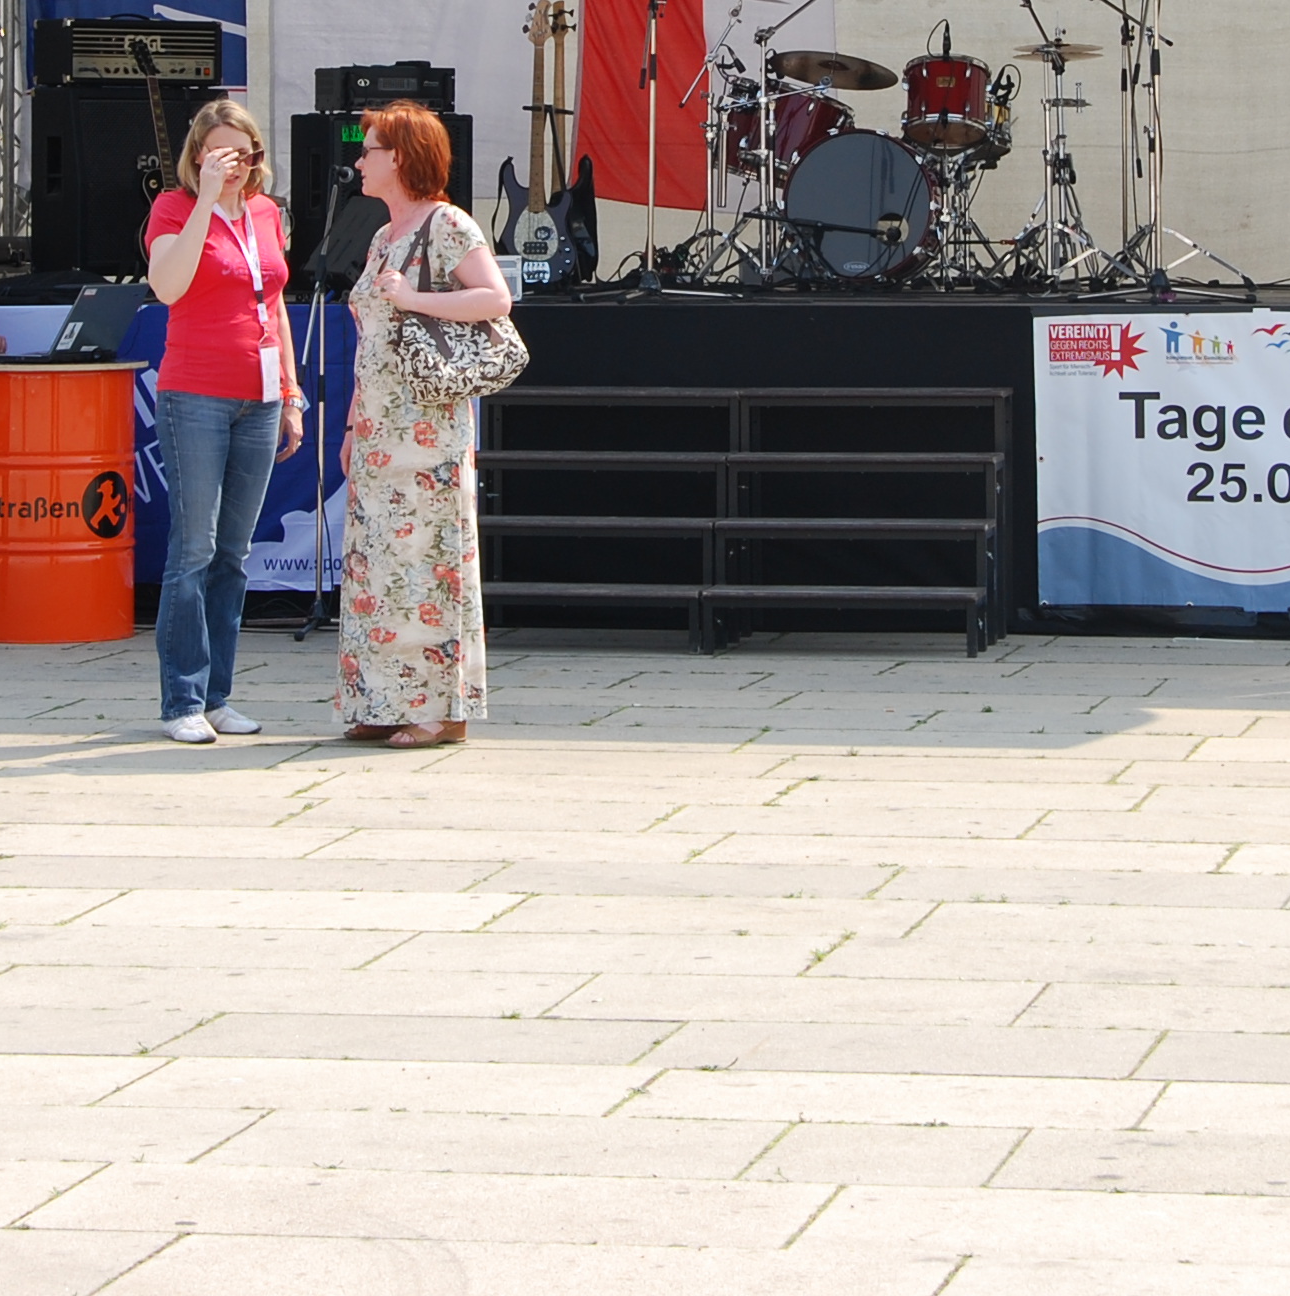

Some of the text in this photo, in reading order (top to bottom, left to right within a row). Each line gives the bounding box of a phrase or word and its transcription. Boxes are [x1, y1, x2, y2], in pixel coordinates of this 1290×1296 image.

[1049, 325, 1110, 339] VEREIN(T)
[1050, 340, 1078, 350] GEGEN
[1050, 350, 1111, 361] EXTREMISMUS
[1119, 391, 1265, 452] Tage
